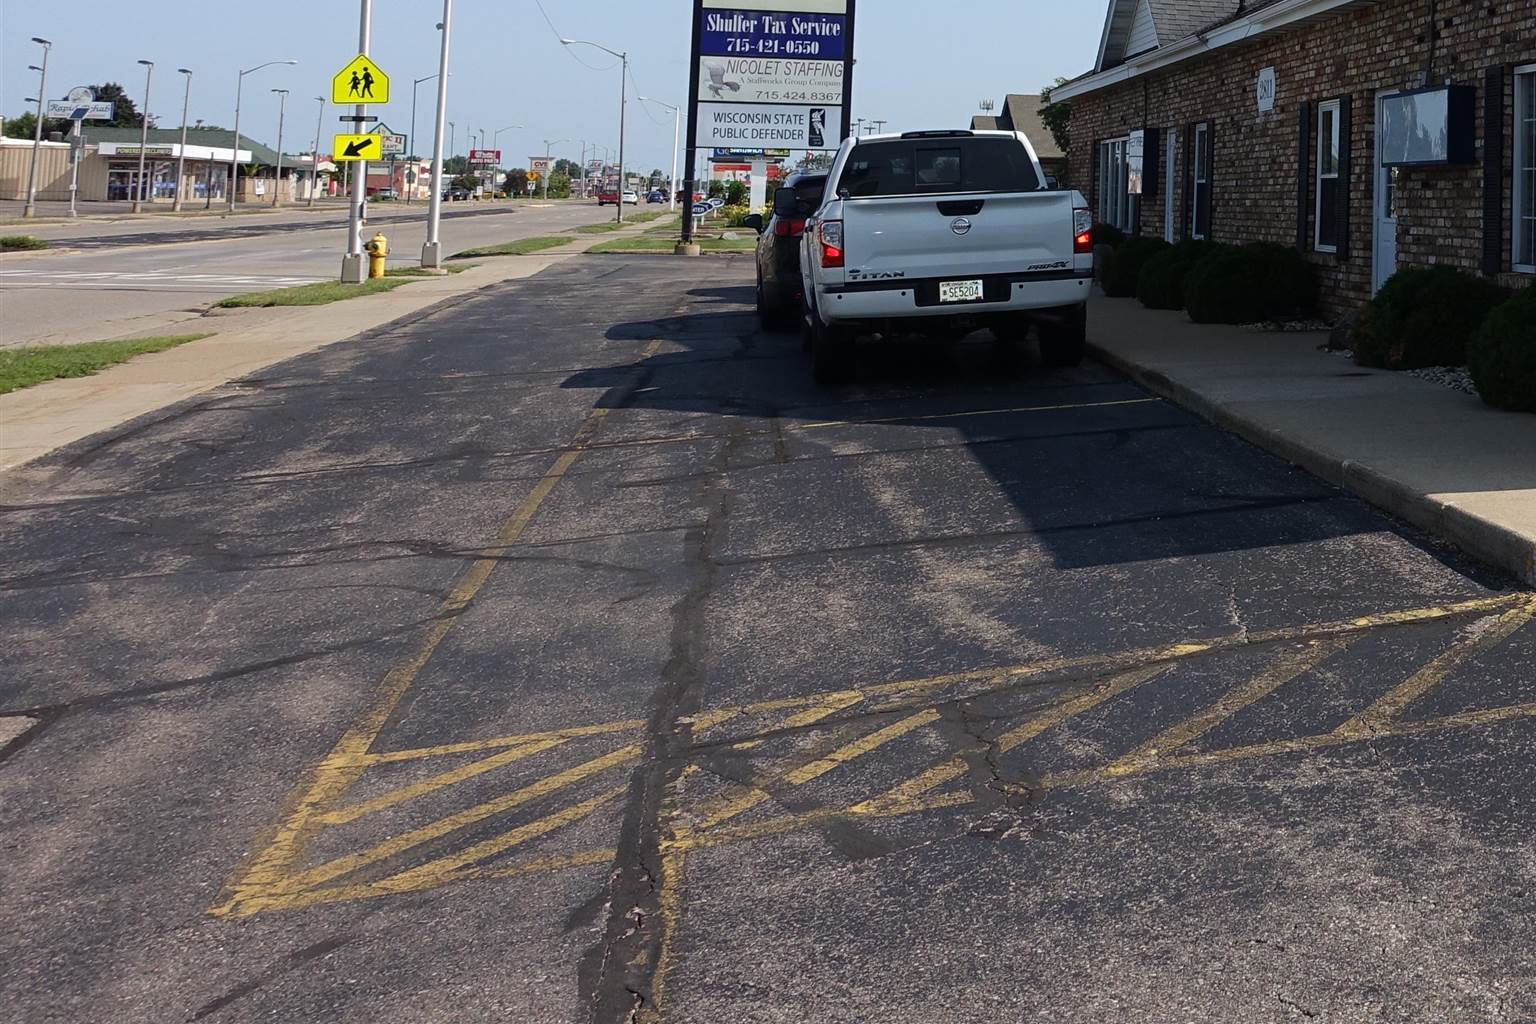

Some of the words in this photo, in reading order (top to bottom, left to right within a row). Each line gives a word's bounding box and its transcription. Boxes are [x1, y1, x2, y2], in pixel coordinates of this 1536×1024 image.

[706, 13, 758, 33] Shulfer
[762, 16, 787, 34] Tax
[791, 17, 840, 36] Service
[726, 38, 820, 54] 715-421-0550
[725, 59, 781, 75] NICOLET
[784, 61, 843, 77] STAFFING
[784, 78, 808, 87] Group
[755, 90, 841, 102] 715.424.8367
[713, 112, 772, 125] WISCONSIN
[774, 114, 804, 125] STATE
[712, 127, 749, 139] PUBLIC
[751, 128, 804, 140] DEFENDER
[849, 269, 905, 280] TITAN
